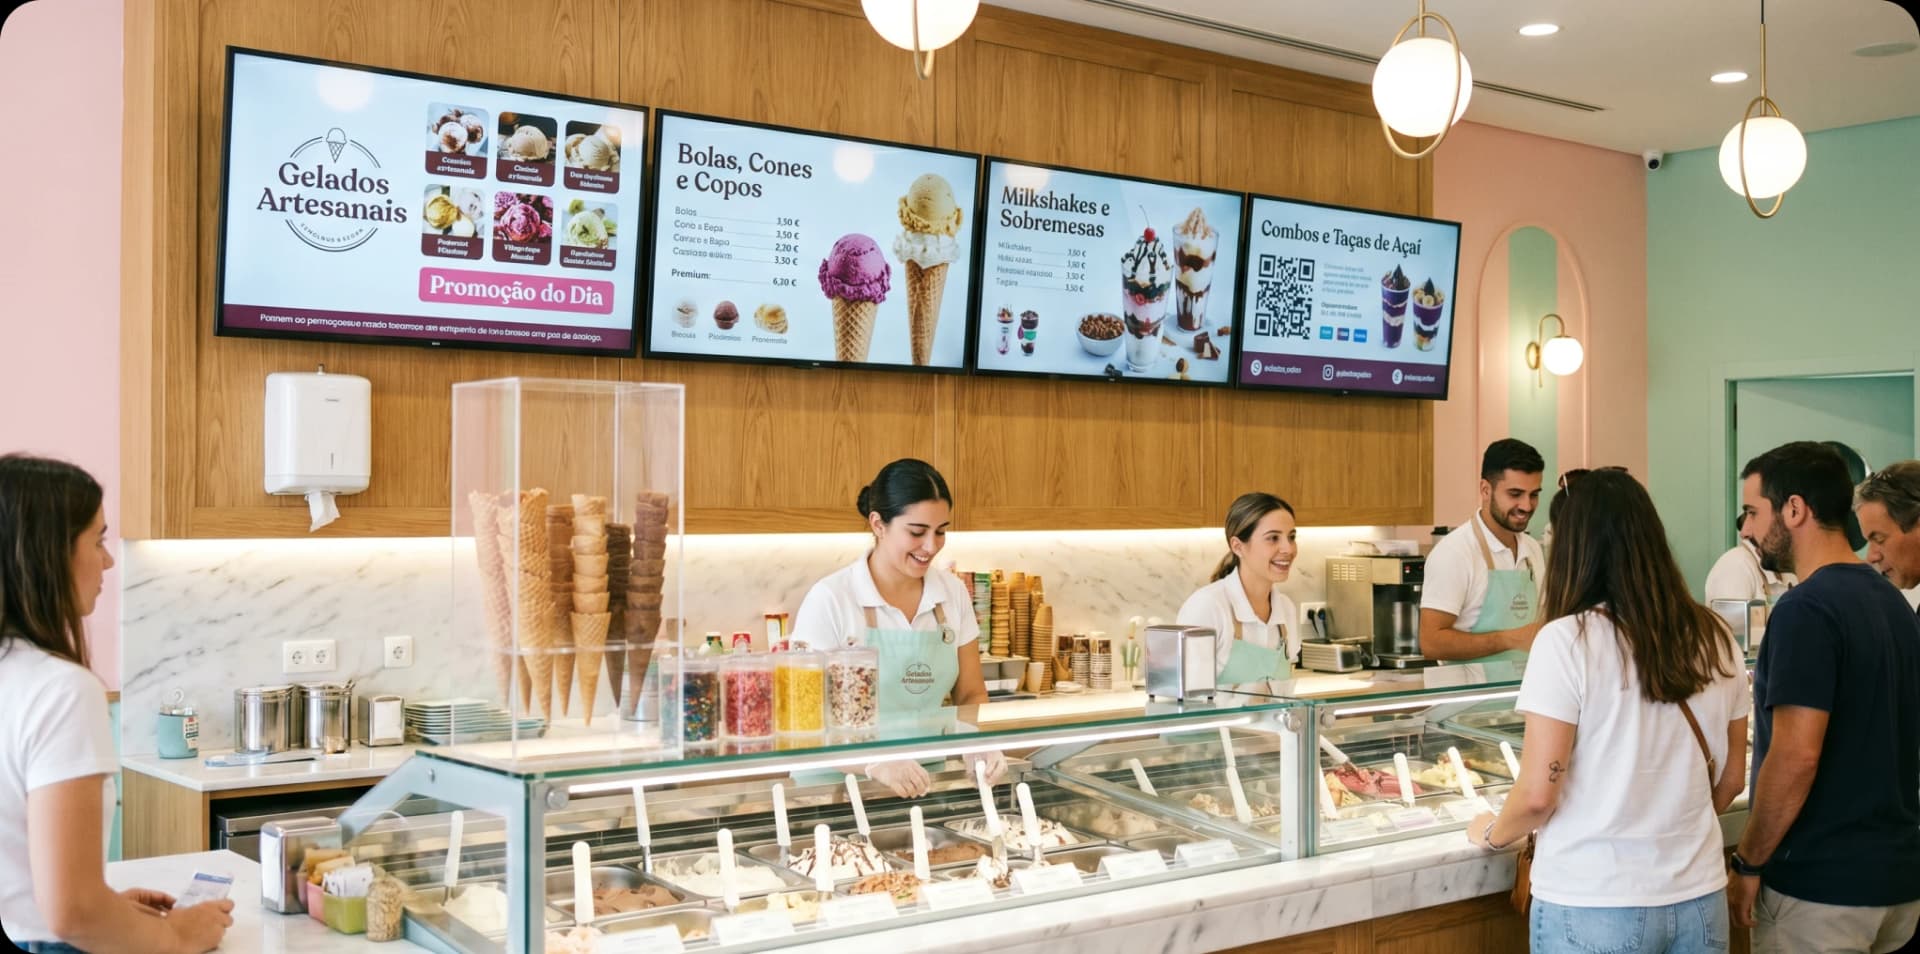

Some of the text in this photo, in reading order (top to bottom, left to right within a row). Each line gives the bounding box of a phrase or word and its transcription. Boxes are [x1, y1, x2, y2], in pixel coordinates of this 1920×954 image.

[678, 143, 812, 179] Bolas, Cones
[279, 162, 389, 195] Gelados
[676, 171, 762, 200] e Copos
[257, 187, 408, 224] Artesanais
[1001, 186, 1110, 216] Milkshakes e
[1000, 209, 1104, 238] Sobremesas
[1261, 220, 1422, 258] Combos e Taças de Açaí
[671, 268, 711, 280] Premium:
[430, 275, 603, 305] Promoção do Dia
